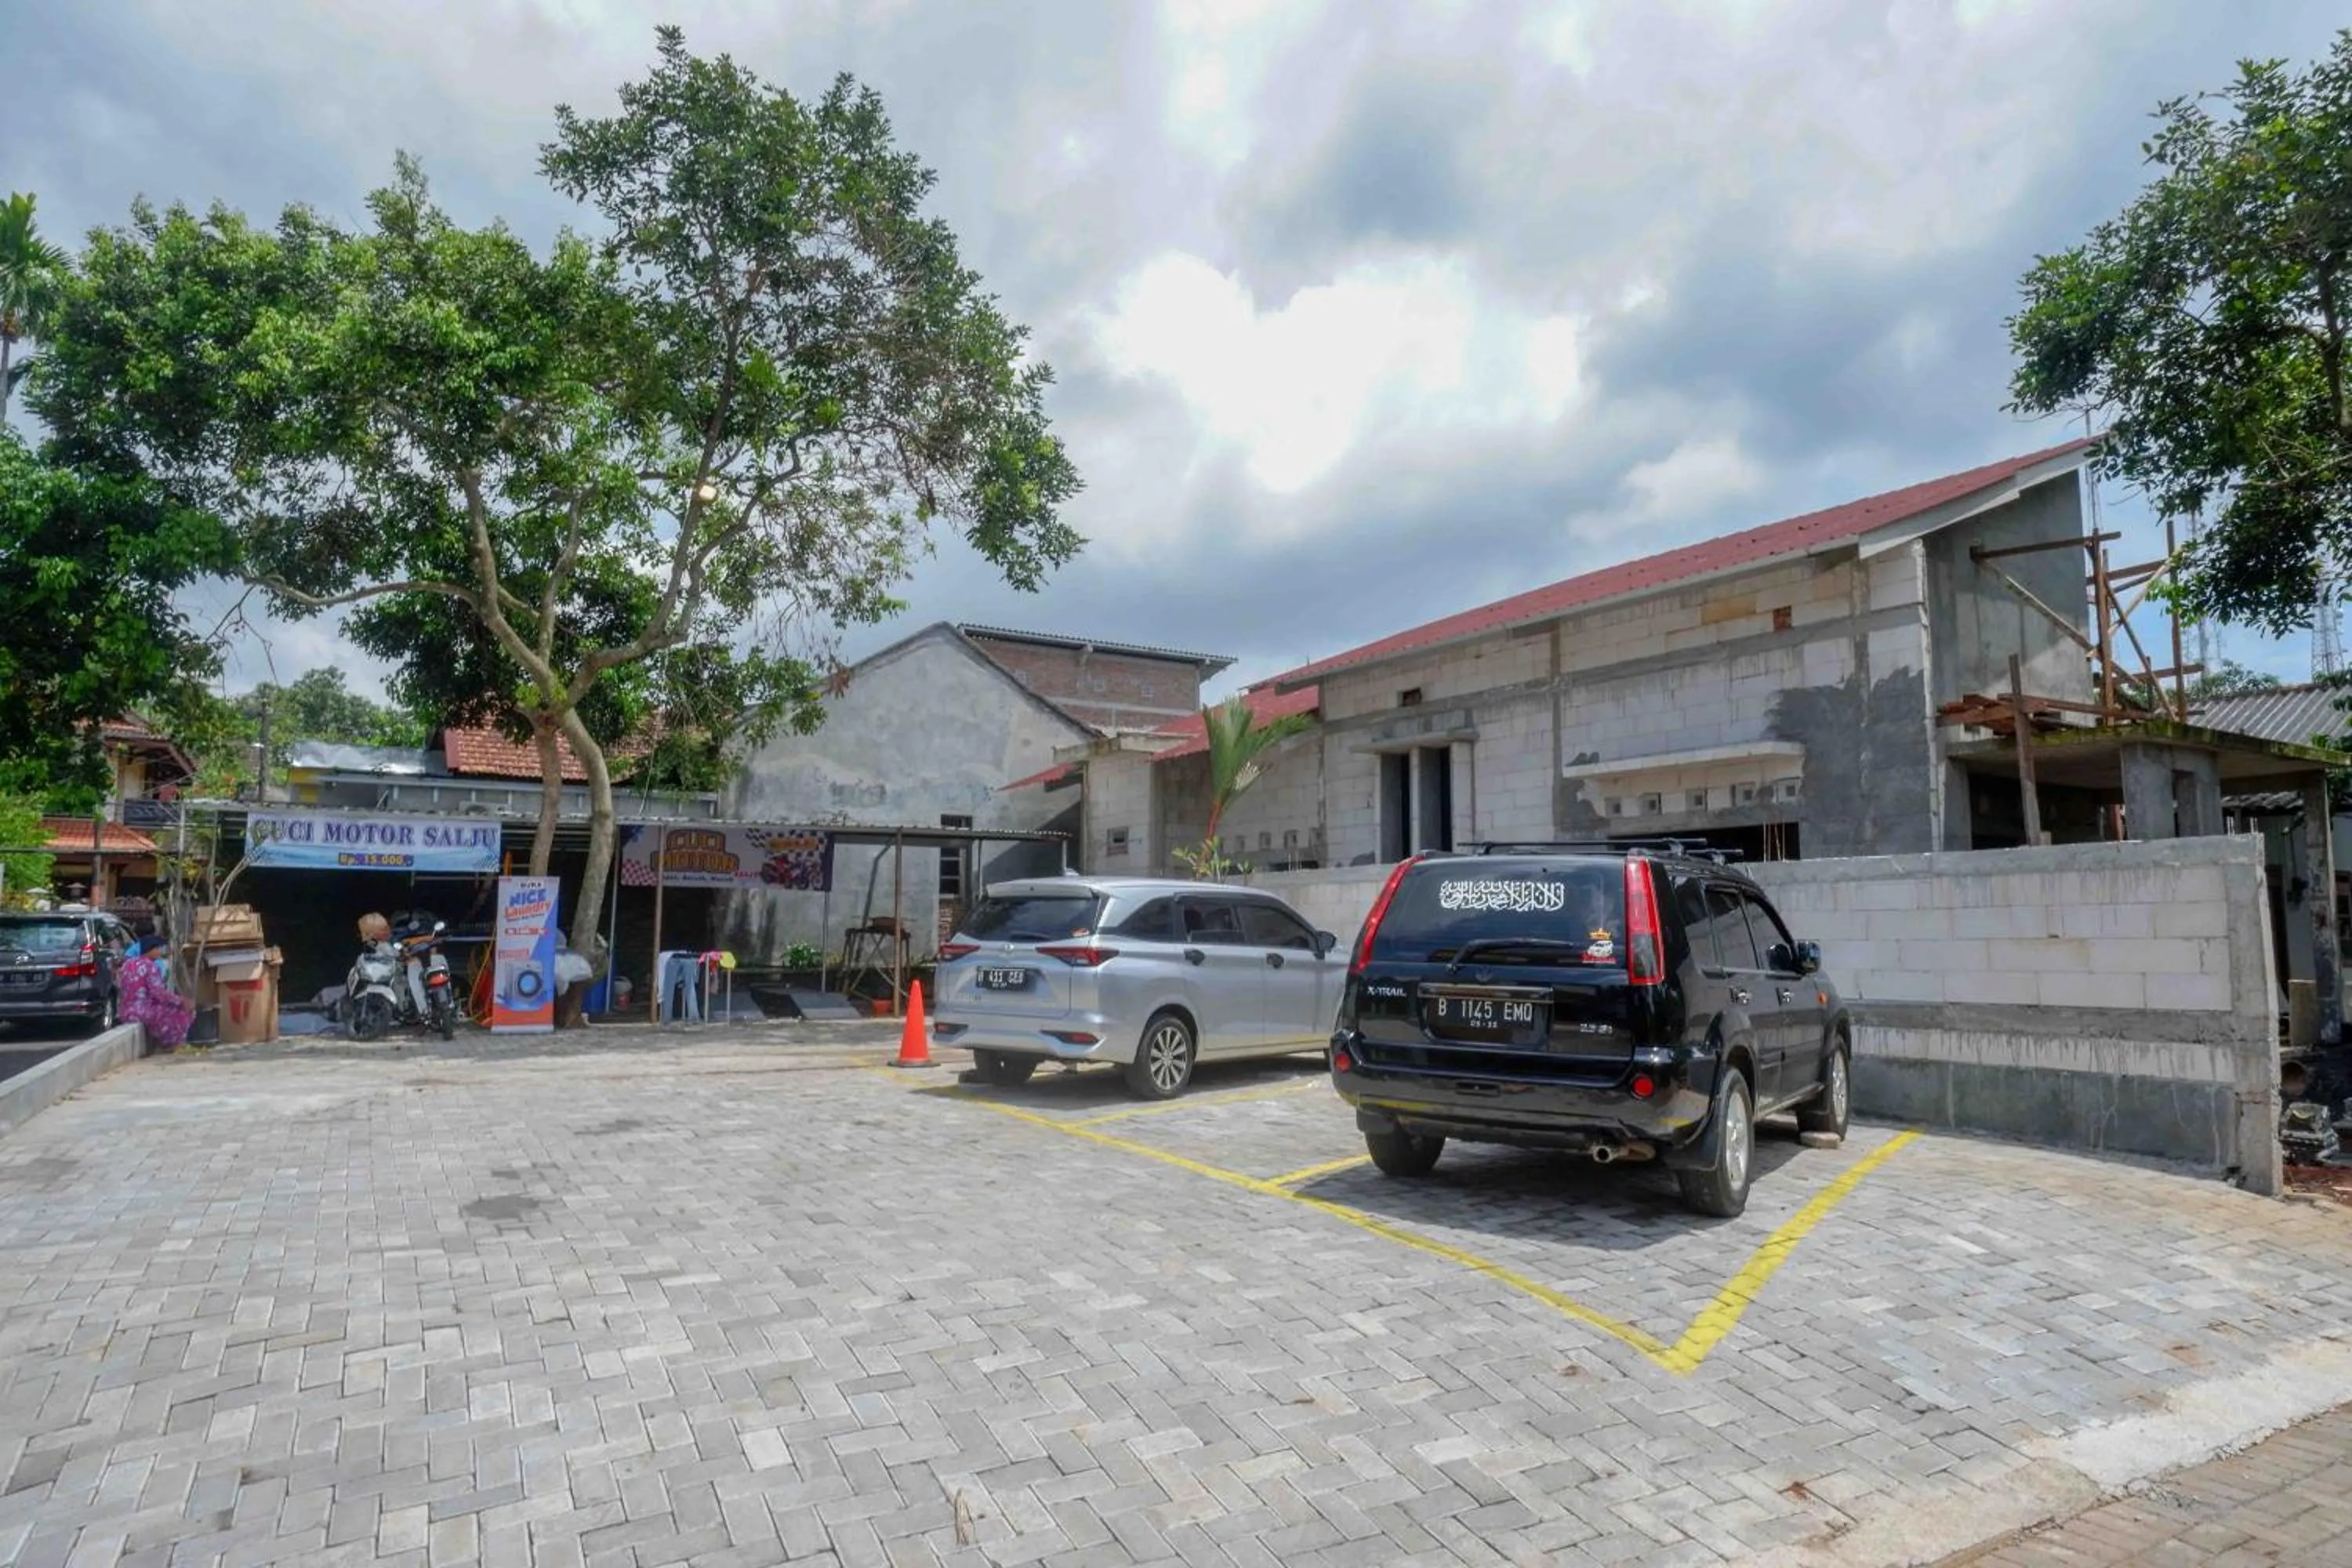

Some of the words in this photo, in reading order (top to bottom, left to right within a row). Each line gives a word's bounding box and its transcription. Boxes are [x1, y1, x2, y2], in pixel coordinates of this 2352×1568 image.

[323, 822, 415, 844] MOTOR
[423, 826, 499, 848] SALJU
[509, 889, 546, 906] NICE
[1367, 985, 1407, 997] X-TRAIL
[1438, 998, 1446, 1016] B
[1461, 1000, 1493, 1019] 1145
